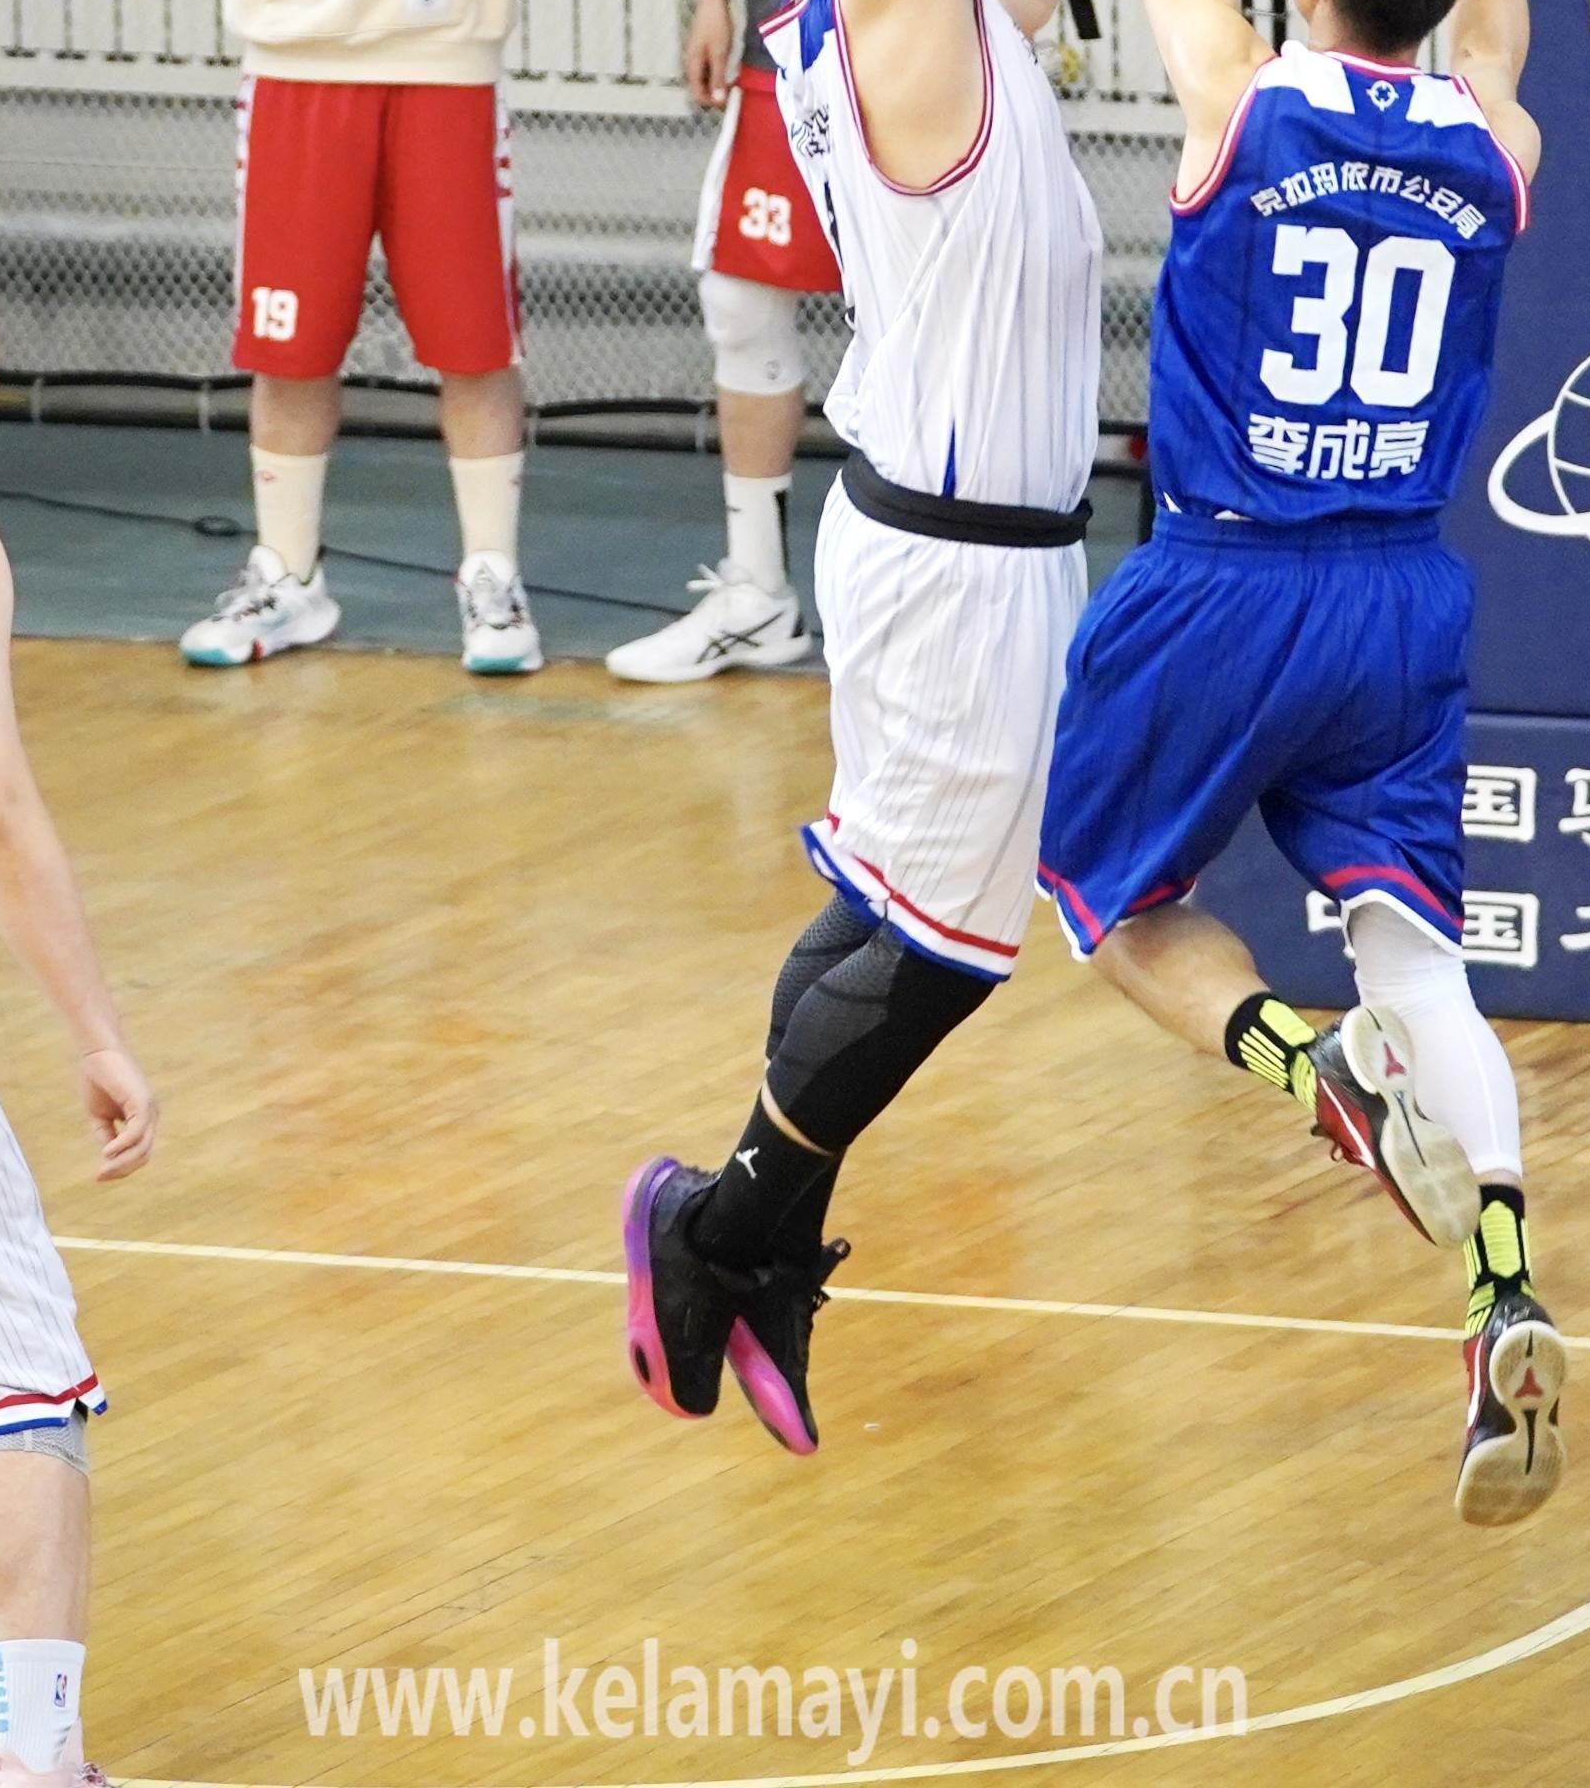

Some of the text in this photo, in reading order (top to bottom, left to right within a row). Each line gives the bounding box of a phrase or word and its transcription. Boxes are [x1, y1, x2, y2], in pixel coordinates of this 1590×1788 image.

[740, 187, 792, 246] 33
[1250, 161, 1488, 240] 克拉玛依市公安局
[251, 286, 299, 342] 19
[1259, 224, 1456, 408] 30
[1248, 412, 1430, 481] 李成亮
